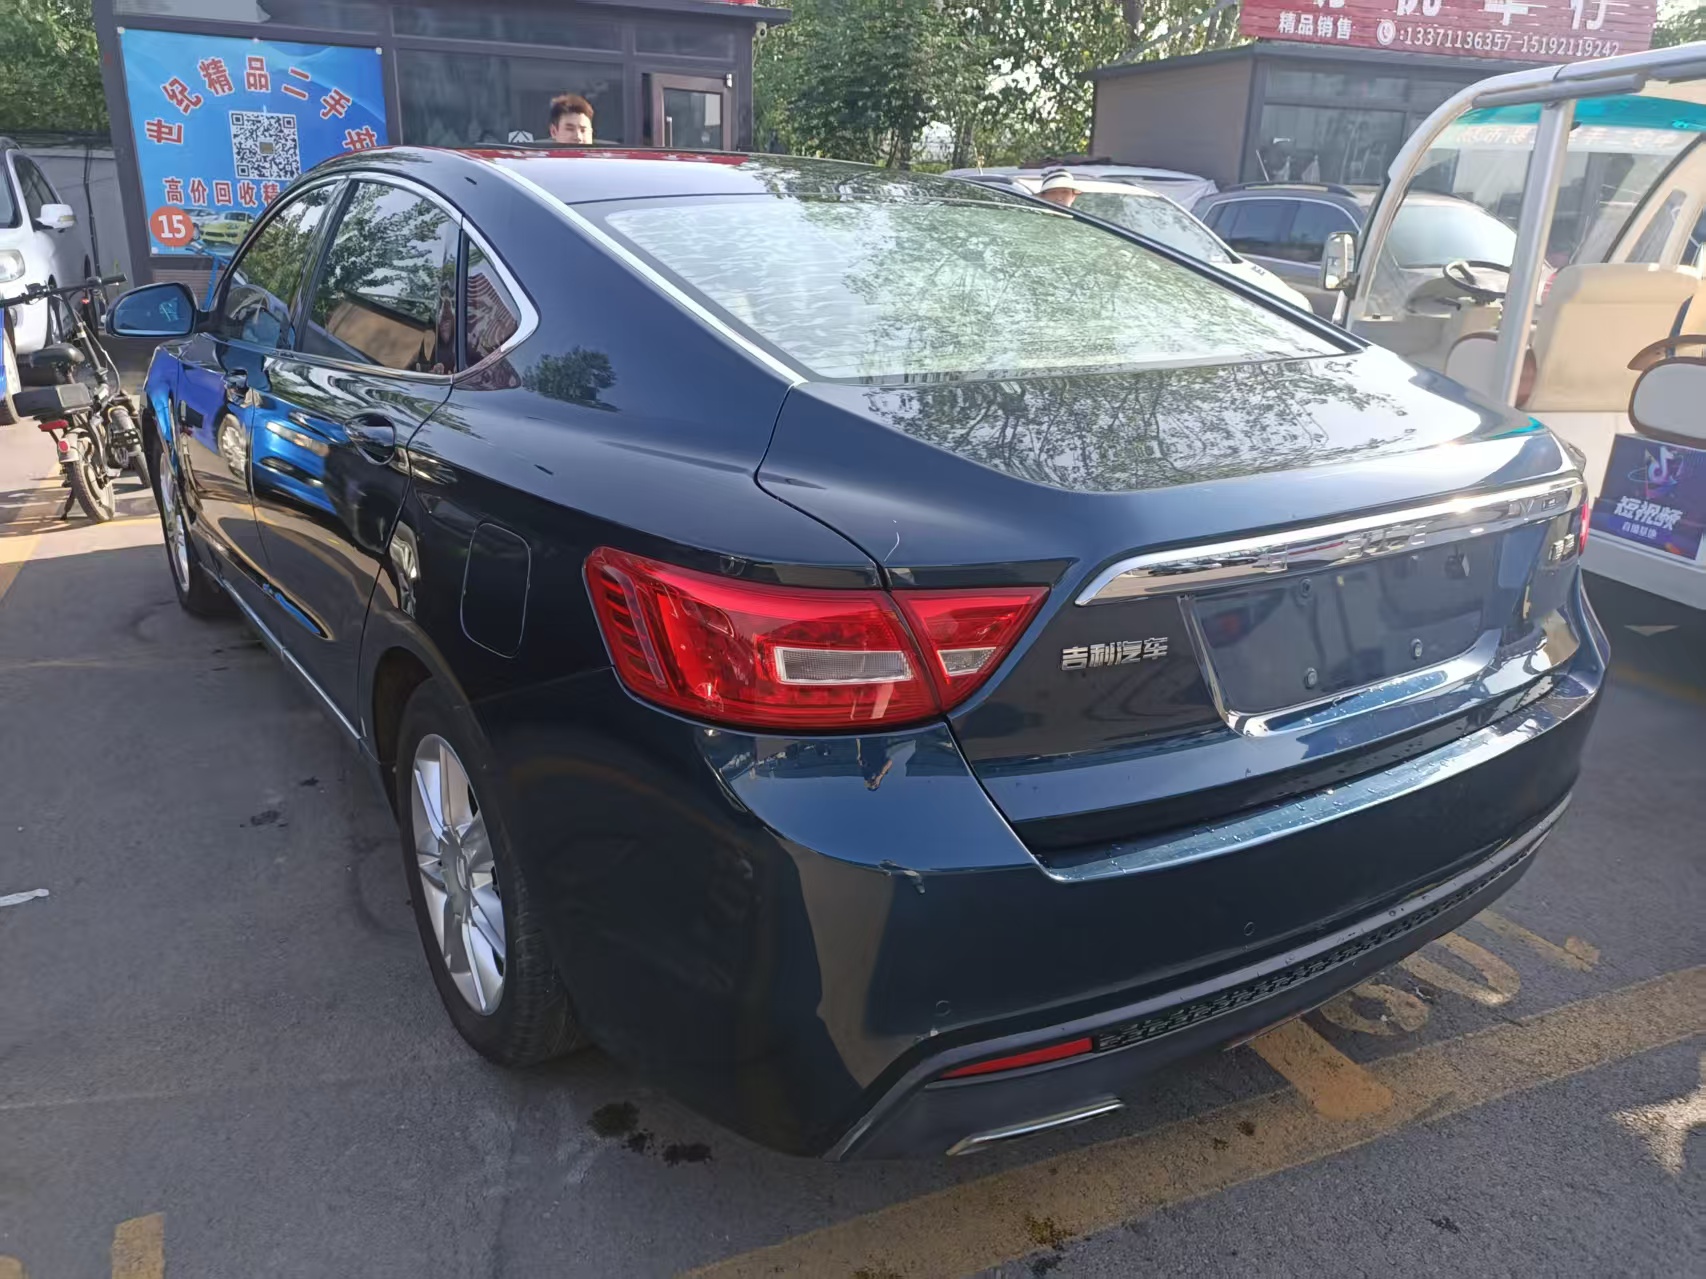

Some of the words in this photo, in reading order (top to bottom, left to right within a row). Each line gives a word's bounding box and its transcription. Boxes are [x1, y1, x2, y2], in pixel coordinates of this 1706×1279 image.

[1278, 11, 1353, 40] 精品销售
[157, 214, 187, 239] 15
[1613, 495, 1684, 531] 短视频
[1061, 636, 1169, 671] 吉利汽车
